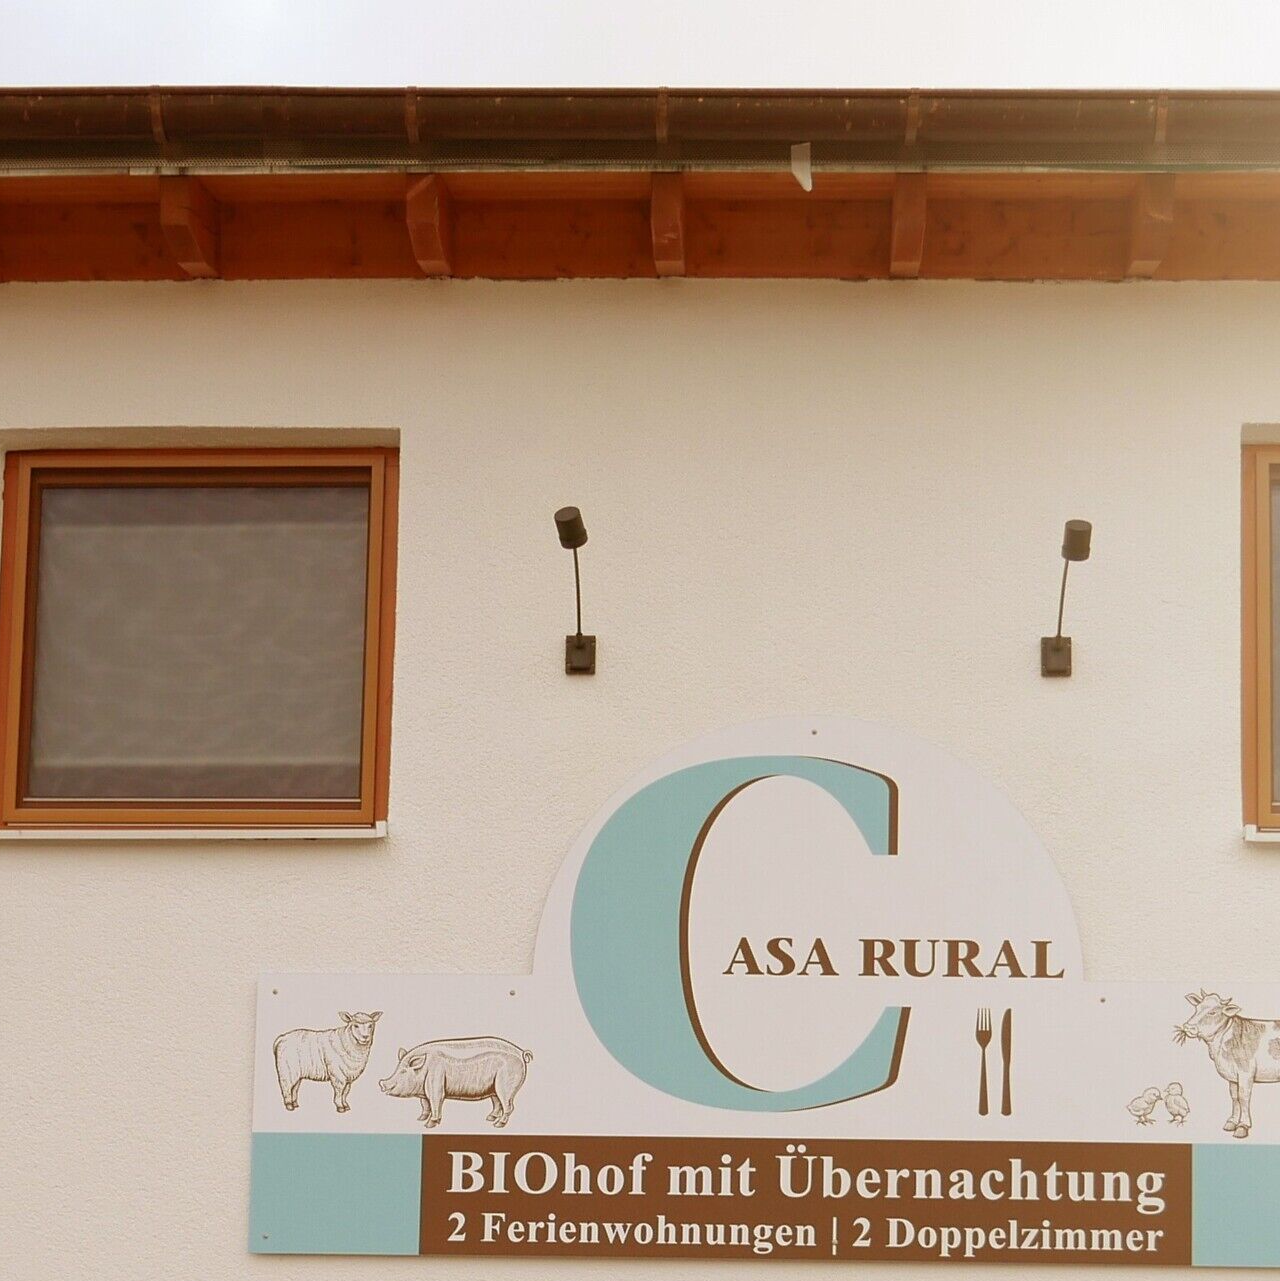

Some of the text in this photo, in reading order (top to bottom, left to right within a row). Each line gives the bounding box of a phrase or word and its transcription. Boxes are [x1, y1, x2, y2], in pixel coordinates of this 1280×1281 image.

[857, 938, 1066, 979] RURAL
[445, 1143, 1166, 1215] BIOhof mit Übernachtung
[446, 1211, 467, 1243] 2
[480, 1211, 817, 1255] Ferienwohnungen
[851, 1217, 872, 1248] 2
[885, 1217, 1165, 1258] Doppelzimmer
